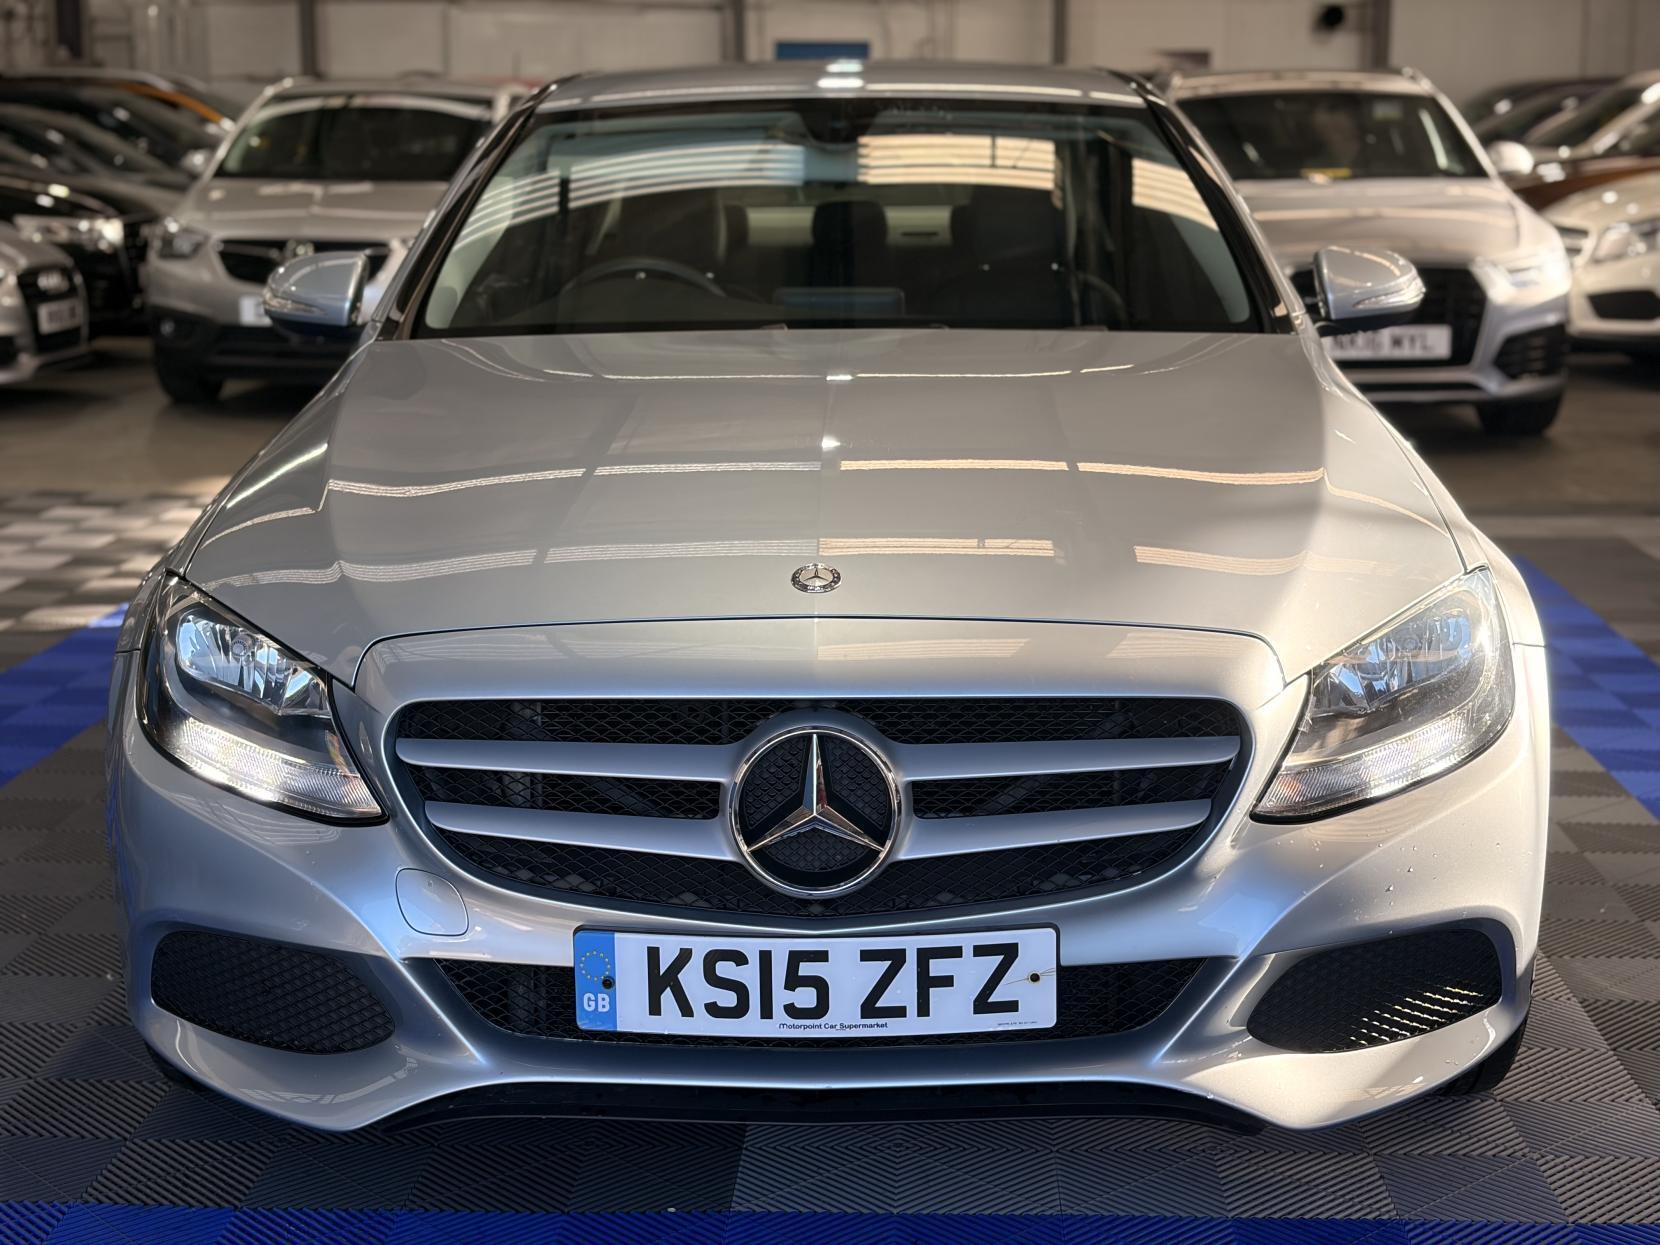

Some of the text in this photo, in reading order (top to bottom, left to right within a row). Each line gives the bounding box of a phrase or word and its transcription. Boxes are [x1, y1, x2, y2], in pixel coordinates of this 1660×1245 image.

[646, 943, 1020, 1020] KS15 ZFZ
[583, 993, 610, 1013] GB
[778, 1021, 888, 1031] Motorpoint Car Supermarket
